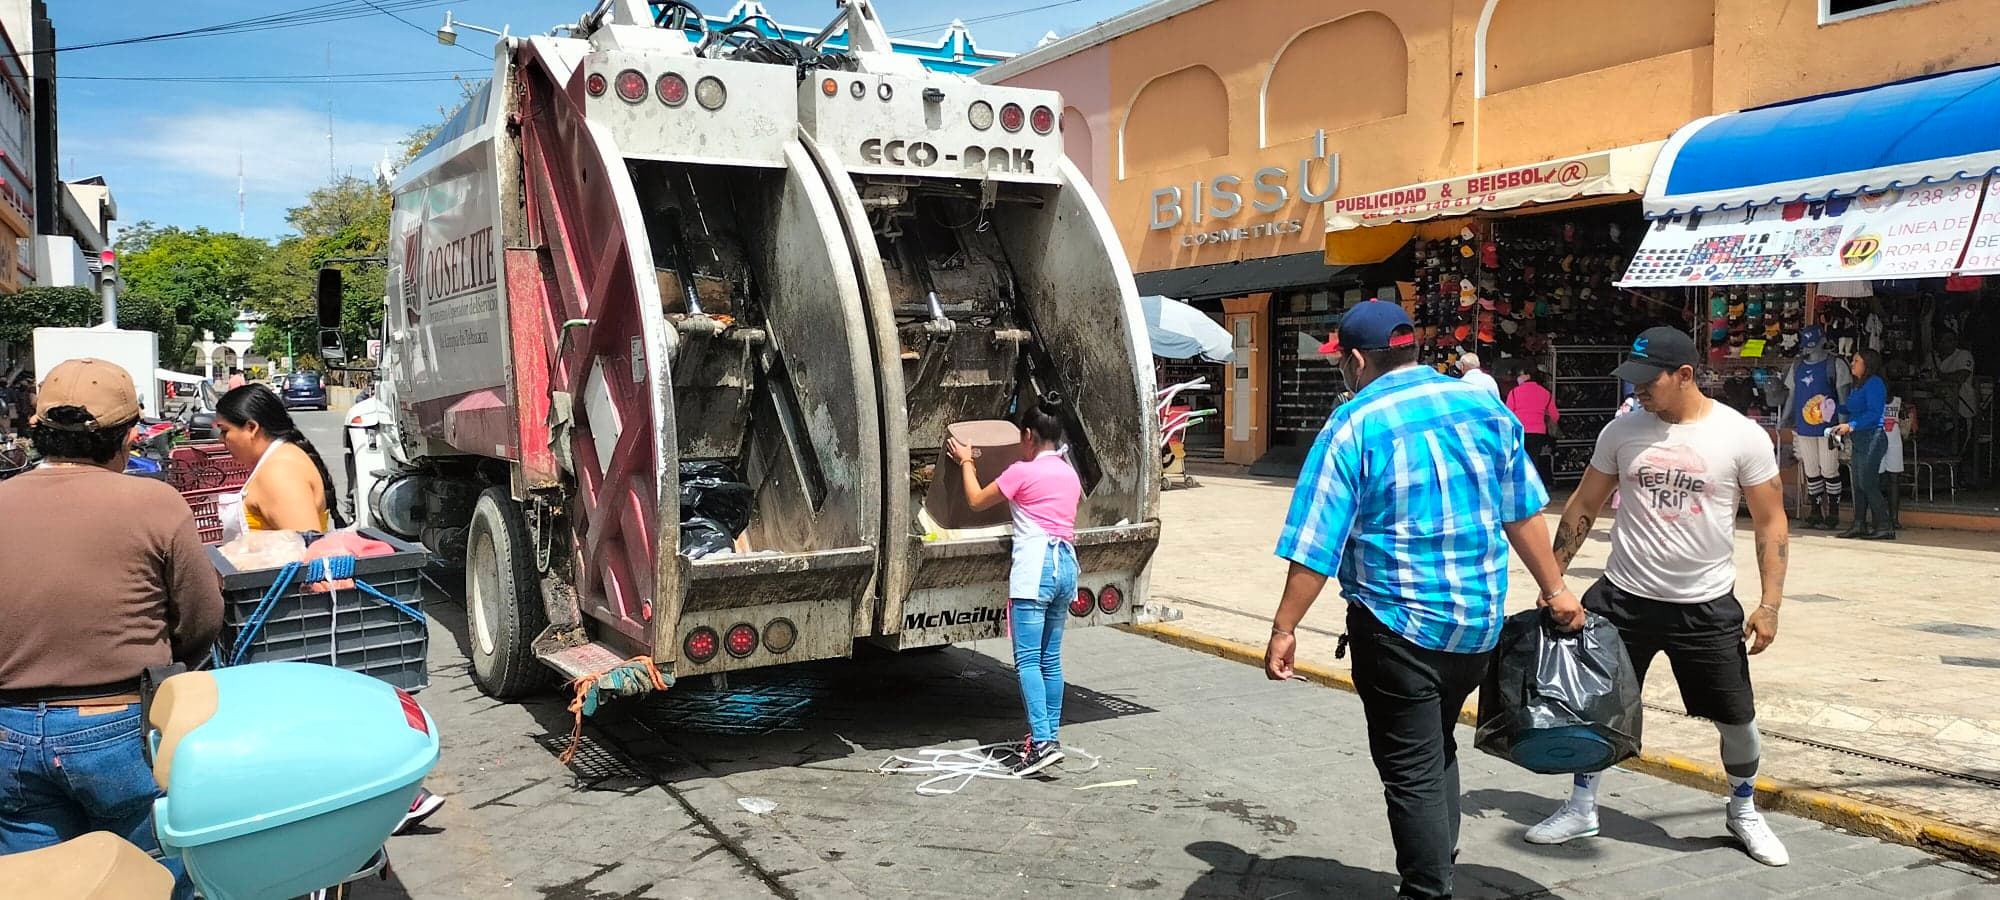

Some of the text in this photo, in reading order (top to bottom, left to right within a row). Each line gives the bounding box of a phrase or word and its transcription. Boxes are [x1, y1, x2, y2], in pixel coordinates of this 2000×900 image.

[1336, 187, 1427, 214] PUBLICIDAD
[1440, 183, 1452, 198] &
[1467, 168, 1543, 194] BEISBOL
[1180, 220, 1303, 248] COSMETICS
[1888, 220, 1938, 237] LINEA
[1942, 216, 1969, 231] DE
[1885, 242, 1930, 257] ROPA
[1934, 239, 1963, 253] DE
[1673, 468, 1705, 493] THE
